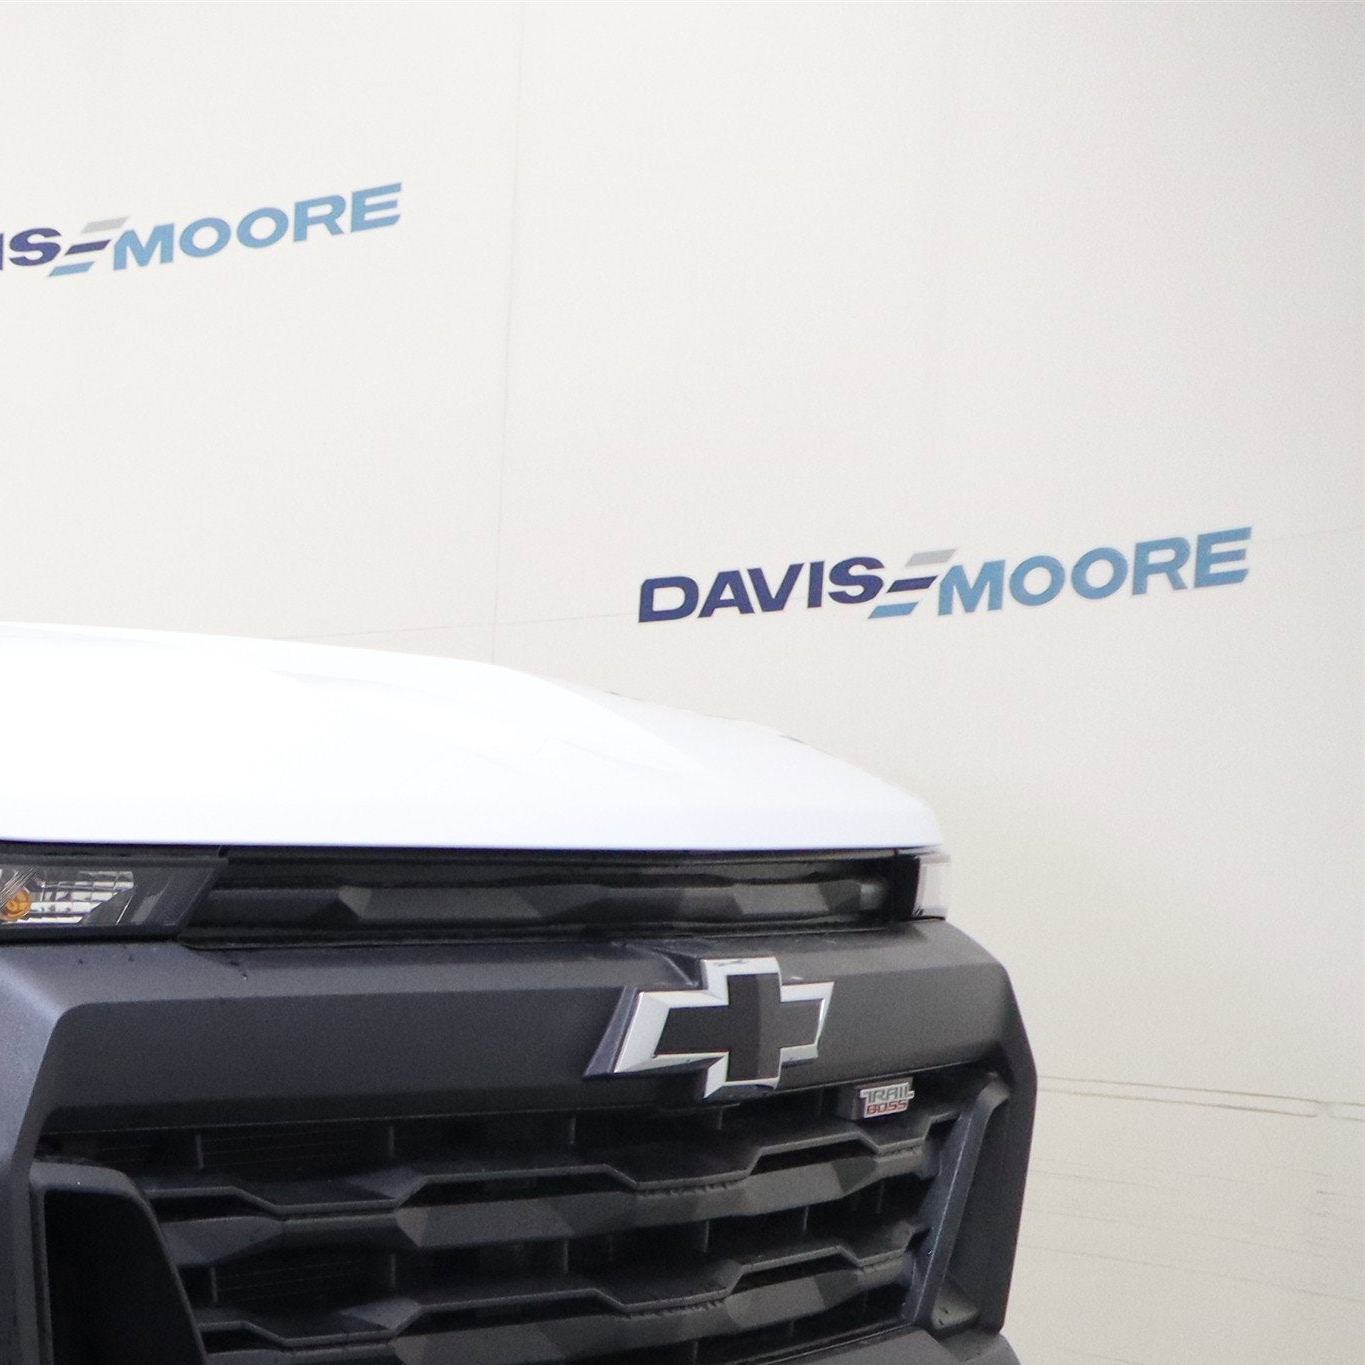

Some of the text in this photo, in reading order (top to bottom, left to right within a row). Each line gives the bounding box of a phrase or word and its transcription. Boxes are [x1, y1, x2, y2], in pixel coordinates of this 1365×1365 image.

[113, 182, 402, 271] MOORE
[639, 526, 1253, 622] DAVIS MOORE
[861, 1083, 914, 1103] TRAIL
[866, 1101, 907, 1116] BOSS
